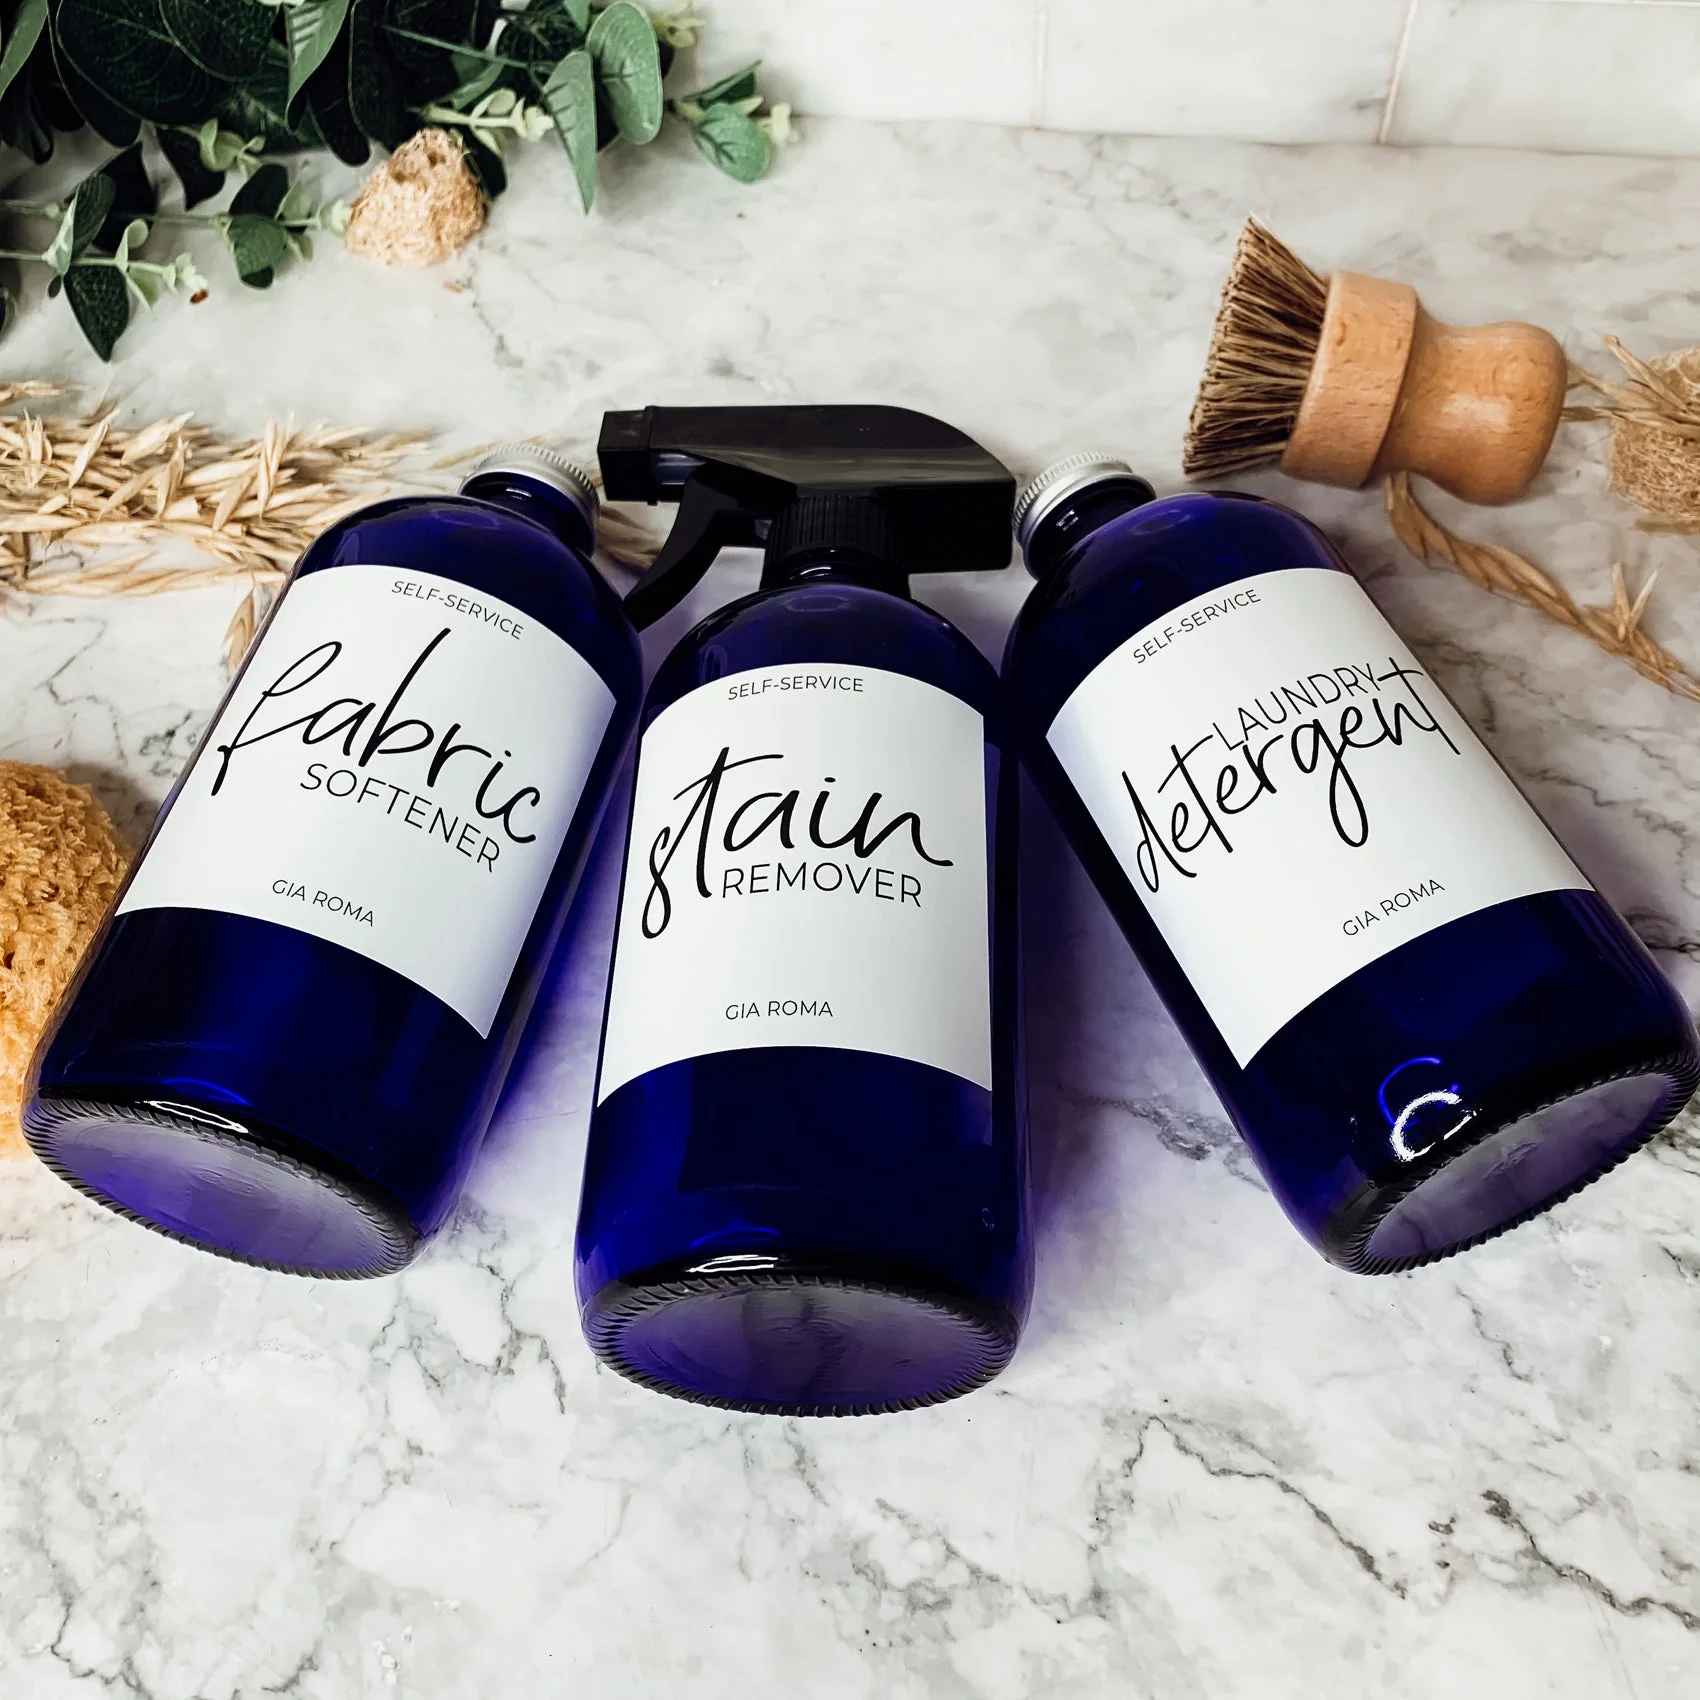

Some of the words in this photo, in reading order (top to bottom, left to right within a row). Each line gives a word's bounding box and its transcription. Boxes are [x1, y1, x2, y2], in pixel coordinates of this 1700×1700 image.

[391, 580, 525, 640] SELF-SERVICE
[1132, 589, 1261, 664] SELF-SERVICE
[728, 676, 864, 700] SELF-SERVICE
[1213, 663, 1378, 750] LAUNDRY
[211, 627, 541, 844] fabric
[1121, 657, 1461, 893] detergent
[299, 763, 501, 873] SOFTENER
[642, 746, 954, 939] stain
[271, 879, 306, 903] GIA
[312, 889, 376, 927] ROMA
[722, 862, 922, 907] REMOVER
[1342, 911, 1380, 938] GIA
[1380, 879, 1447, 918] ROMA
[725, 1002, 761, 1021] GIA
[767, 1000, 834, 1018] ROMA
